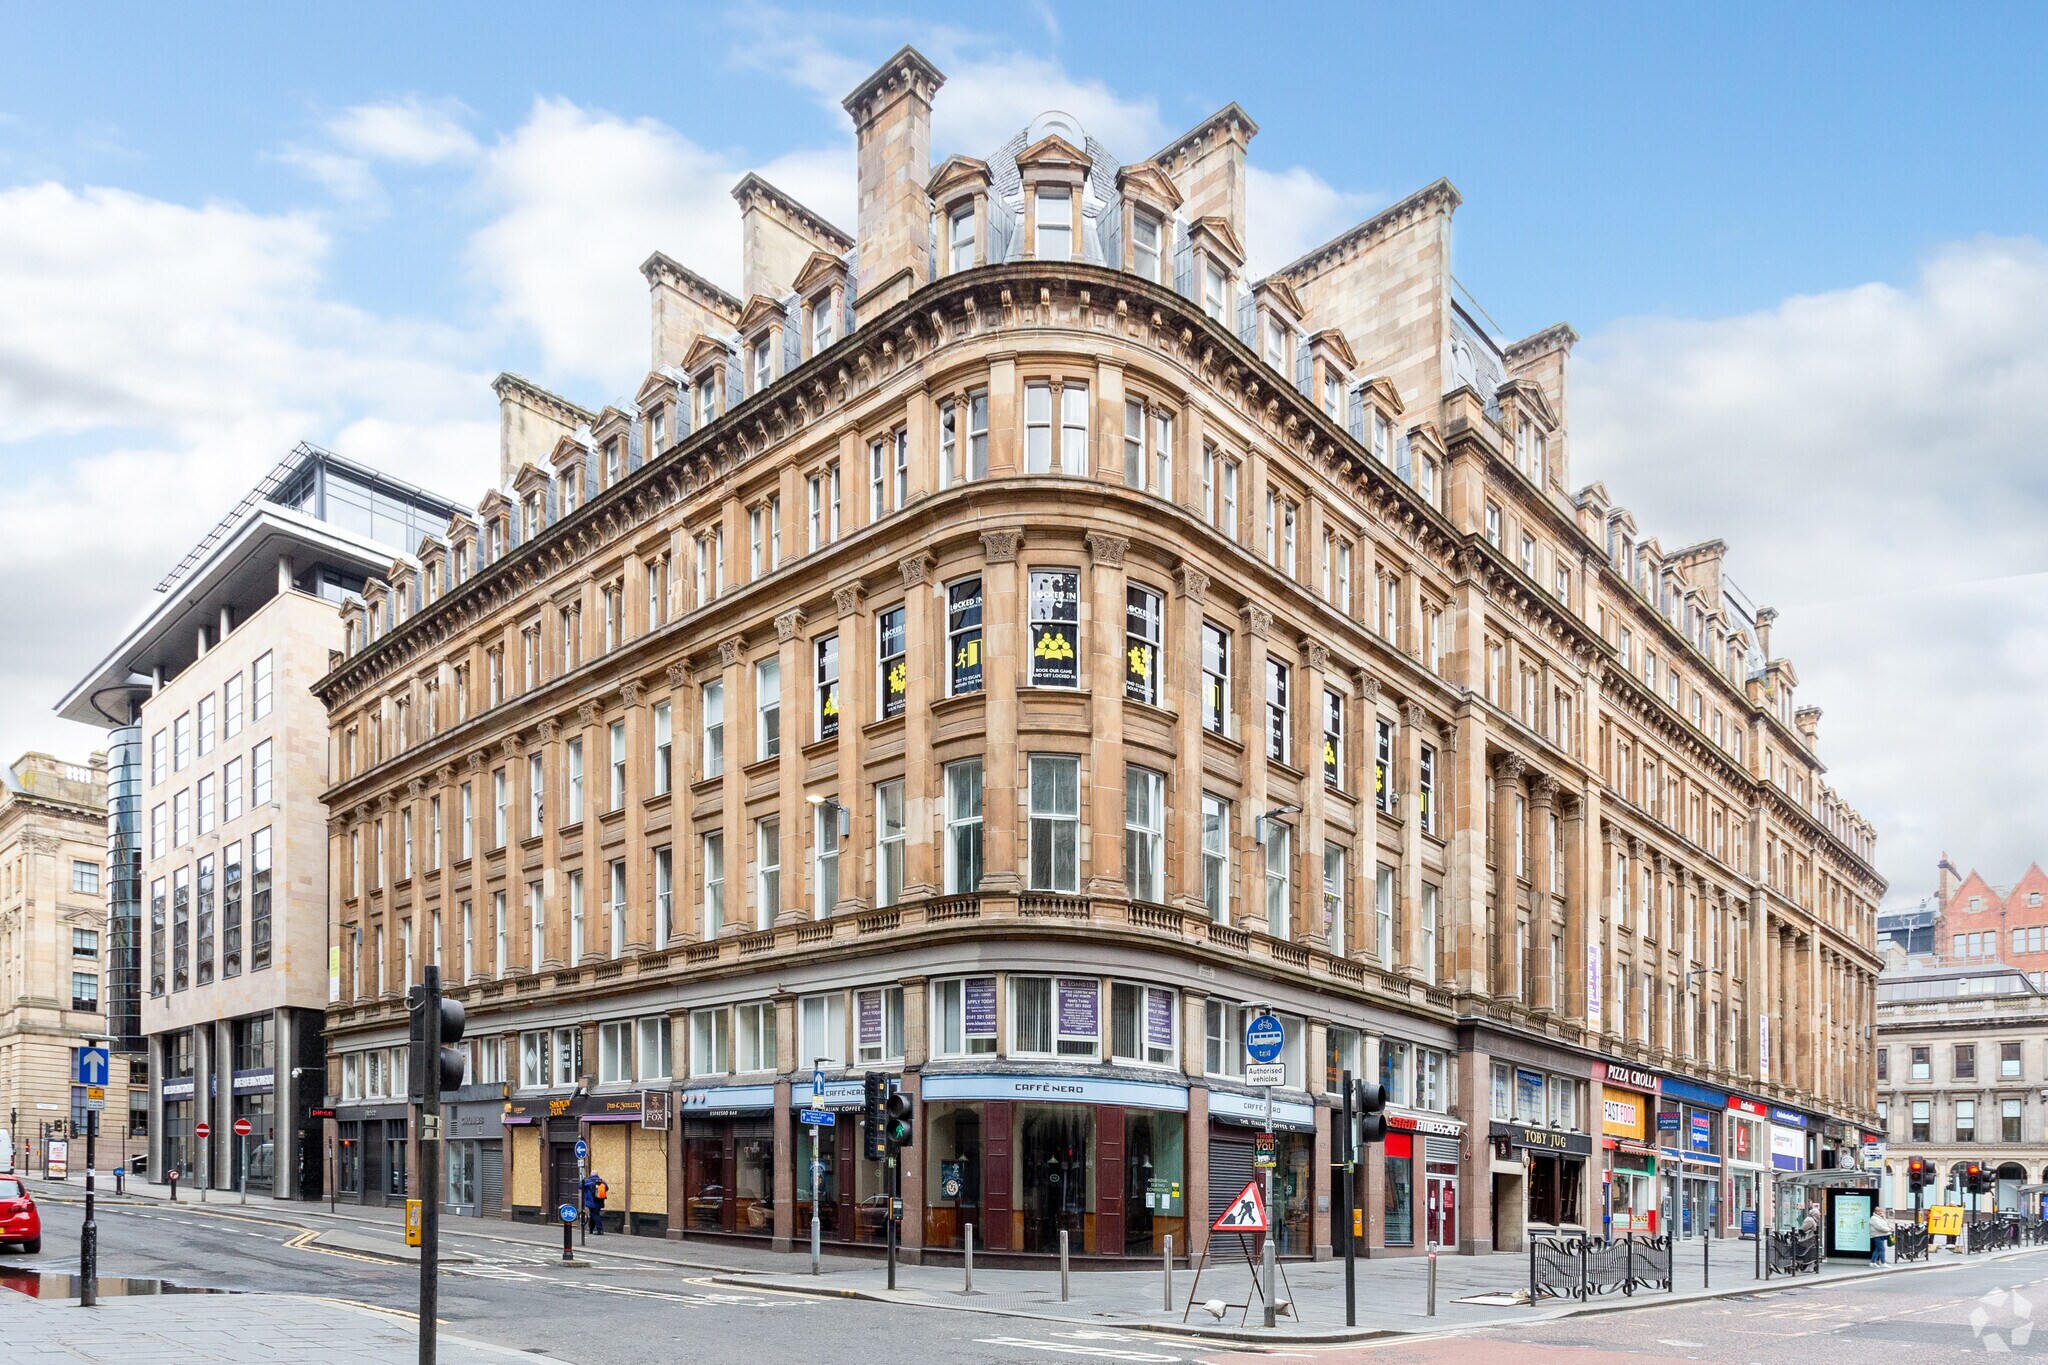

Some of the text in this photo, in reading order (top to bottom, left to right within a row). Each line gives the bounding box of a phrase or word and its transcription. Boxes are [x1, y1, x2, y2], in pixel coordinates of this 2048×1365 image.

[950, 599, 974, 611] LOCKED
[882, 625, 902, 639] LOCKED
[1252, 1075, 1278, 1083] vehicles
[1608, 1064, 1657, 1090] PIZZA CROLLA
[846, 1088, 866, 1096] NERO
[1015, 1082, 1084, 1094] CAFFÈ NERO
[646, 1112, 663, 1122] FOX
[1604, 1101, 1635, 1124] FAST FOOD
[1692, 1118, 1708, 1128] TESCO
[1524, 1129, 1567, 1148] TOBY JUG
[1256, 1143, 1274, 1151] YOU
